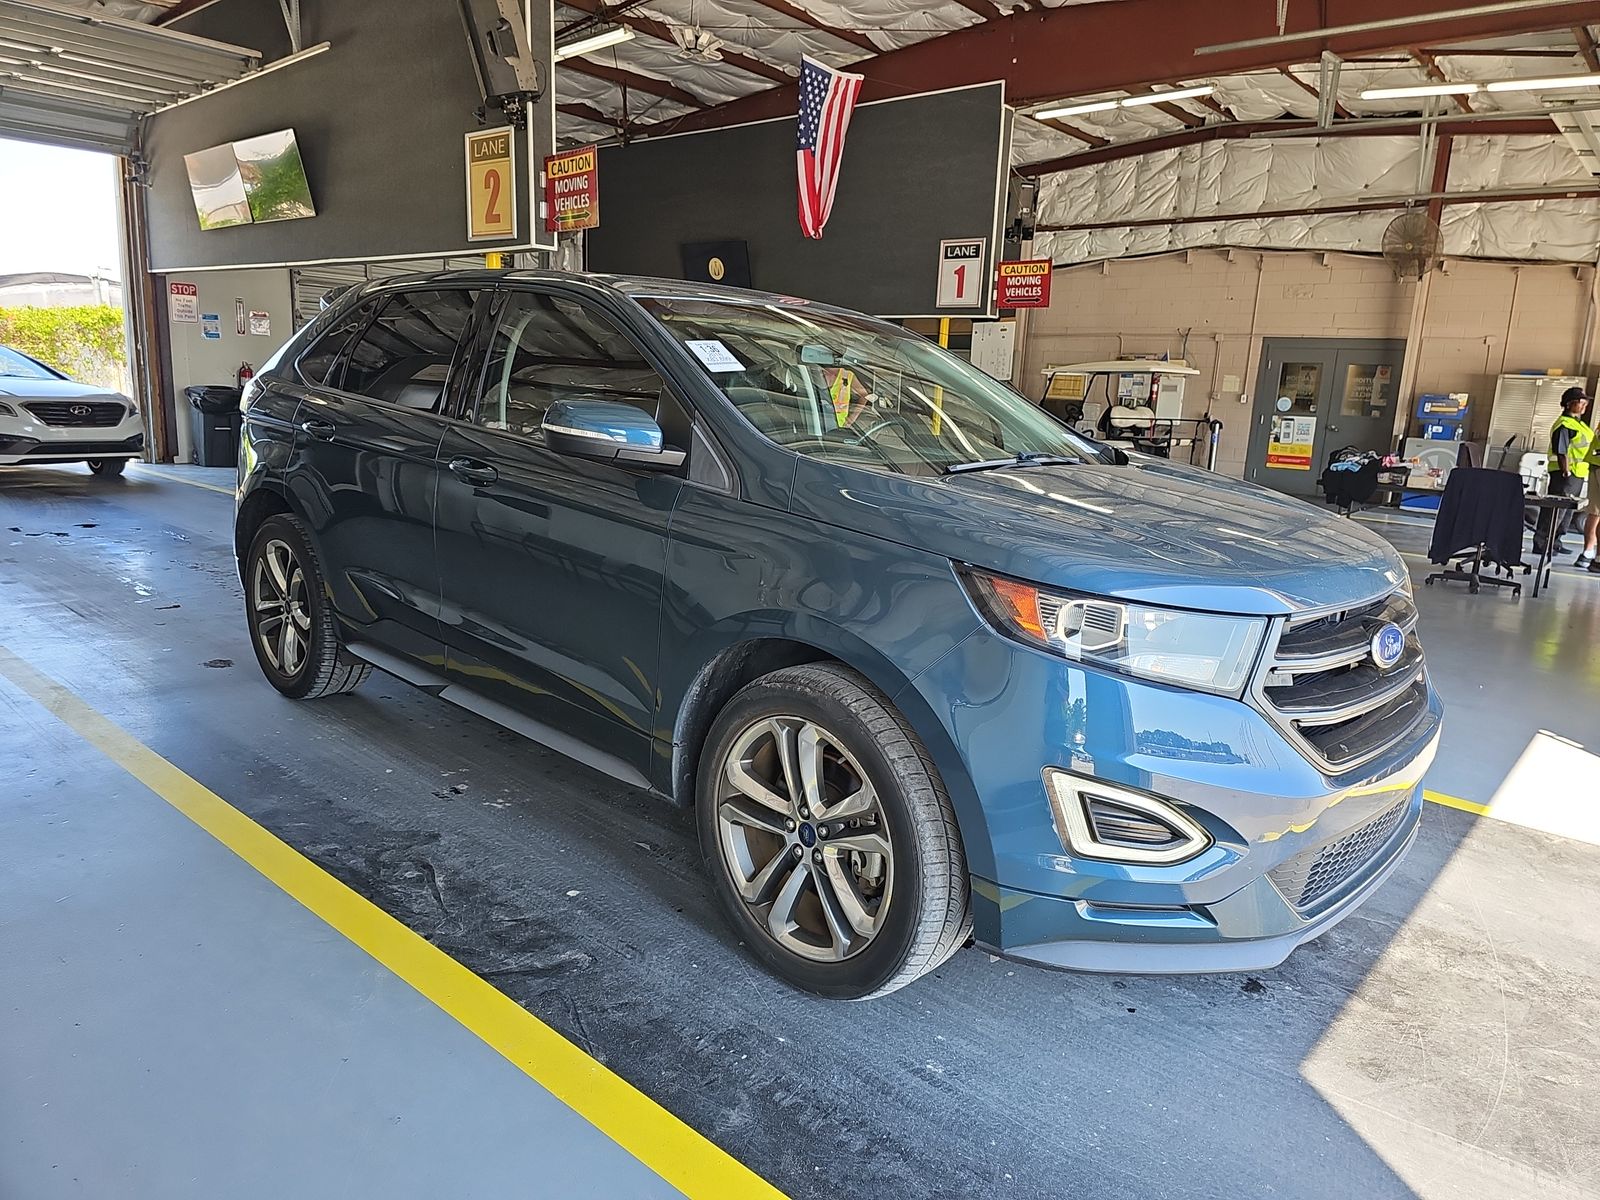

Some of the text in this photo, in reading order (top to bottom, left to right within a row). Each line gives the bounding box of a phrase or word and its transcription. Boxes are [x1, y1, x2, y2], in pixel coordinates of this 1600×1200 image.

[474, 138, 505, 158] LANE
[551, 156, 591, 176] CAUTION
[554, 174, 588, 195] MOVING
[484, 168, 501, 225] 2
[554, 193, 590, 212] VEHICLES
[947, 245, 977, 257] LANE
[1004, 264, 1046, 275] CAUTION
[171, 284, 195, 294] STOP
[954, 264, 966, 299] 1
[1006, 275, 1041, 286] MOVING
[1005, 286, 1042, 297] VEHICLES
[1384, 634, 1402, 659] Ford
